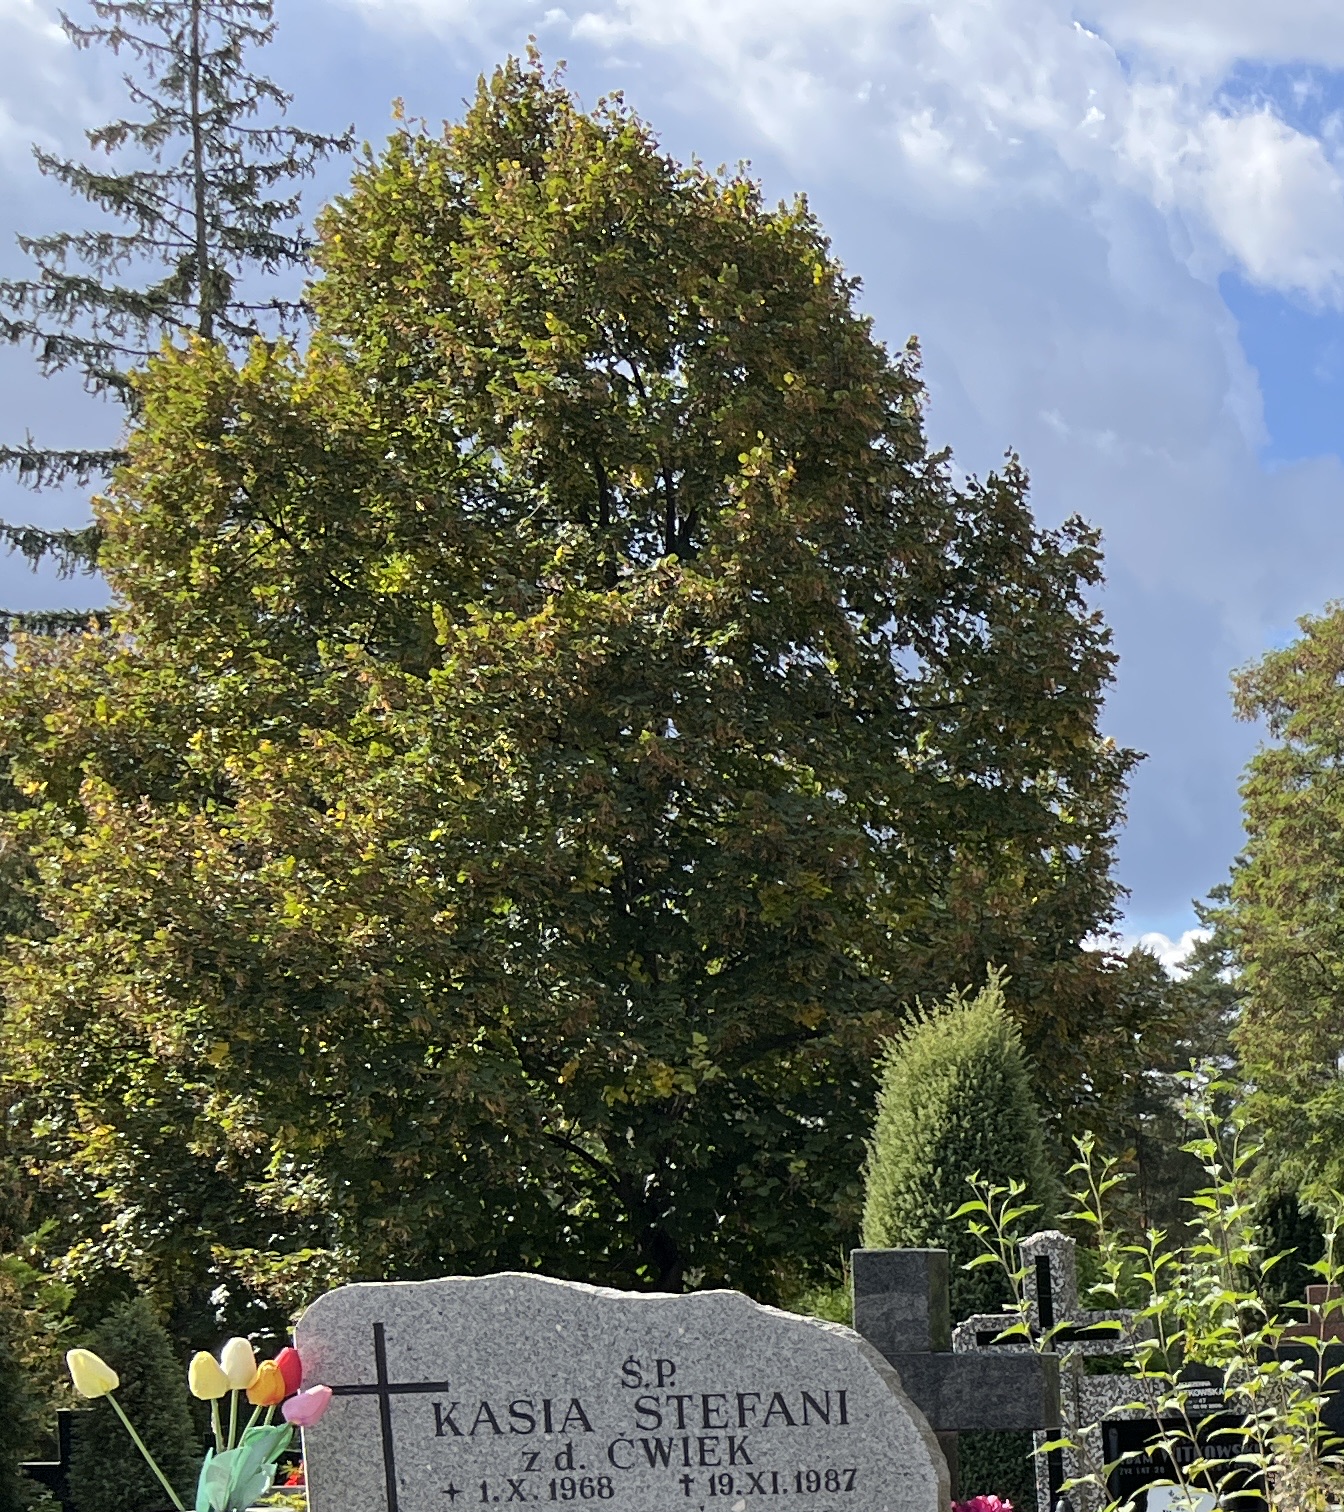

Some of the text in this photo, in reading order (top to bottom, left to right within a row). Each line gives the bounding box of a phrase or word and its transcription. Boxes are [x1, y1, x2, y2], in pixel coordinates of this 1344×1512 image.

[621, 1354, 676, 1389] Ś.P.
[431, 1389, 850, 1438] KASIA STEFANI
